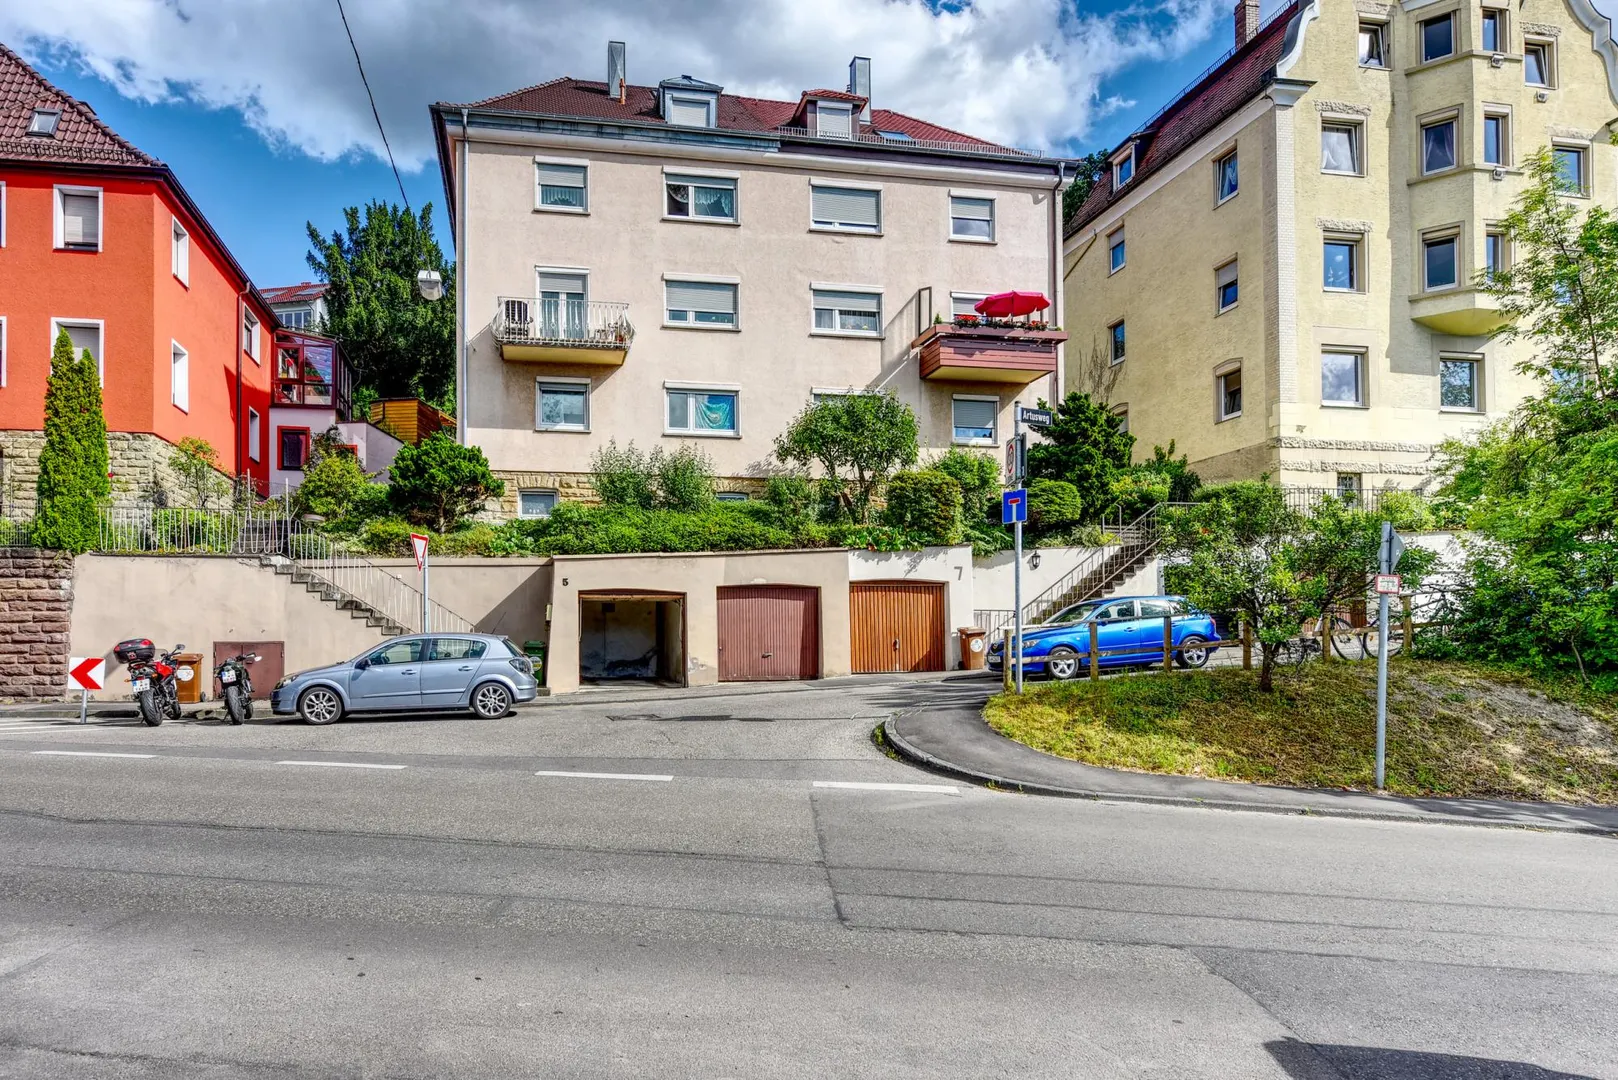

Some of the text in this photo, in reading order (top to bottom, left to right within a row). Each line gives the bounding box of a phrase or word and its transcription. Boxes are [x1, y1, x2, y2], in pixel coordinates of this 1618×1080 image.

[1022, 410, 1050, 425] Artusweg
[954, 566, 963, 581] 7
[562, 577, 569, 587] 5
